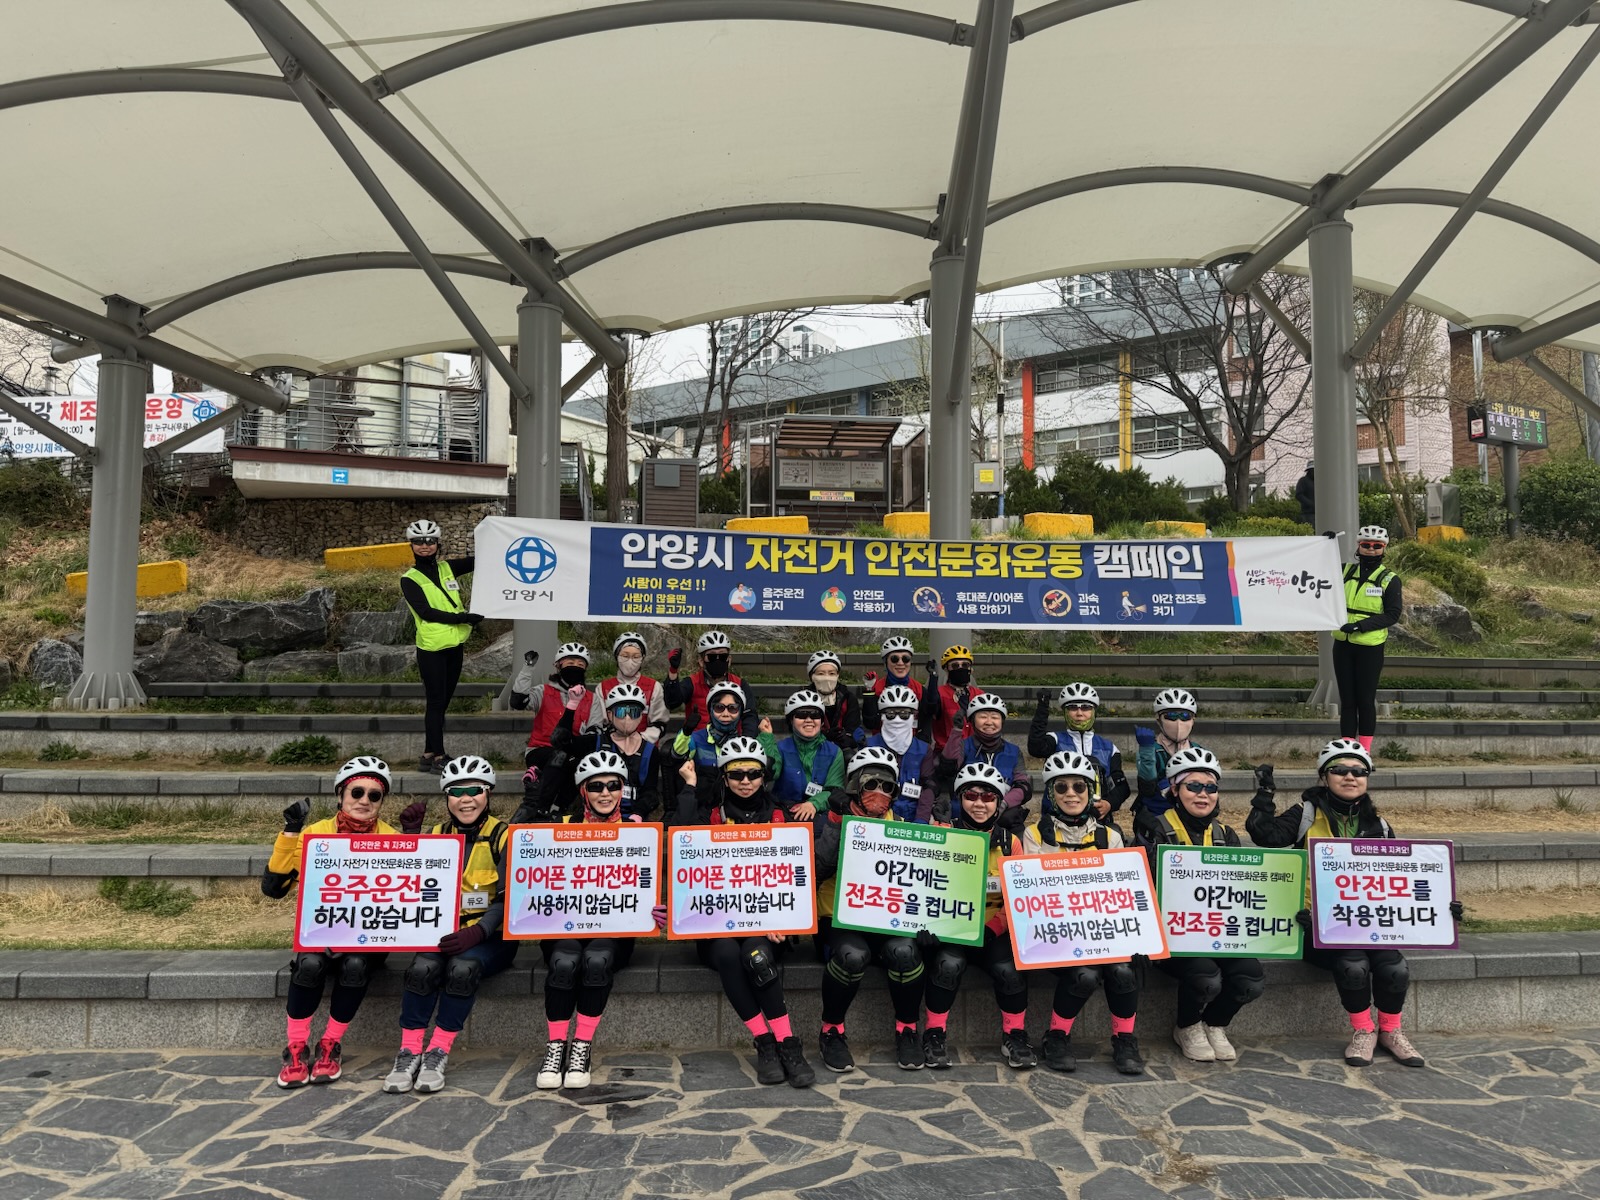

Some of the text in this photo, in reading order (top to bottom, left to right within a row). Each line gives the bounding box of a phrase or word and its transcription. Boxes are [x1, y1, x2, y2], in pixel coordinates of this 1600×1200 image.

[146, 398, 183, 420] 운영
[620, 532, 1204, 580] 안양시 자전거 안전문화운동 캠페인
[623, 577, 662, 590] 사람이
[666, 578, 692, 591] 우선
[1291, 570, 1332, 599] 안양
[502, 589, 553, 602] 안양시
[622, 593, 686, 604] 사람이 많을땐
[762, 588, 804, 599] 음주운전
[853, 590, 884, 600] 안전모
[956, 592, 1024, 603] 휴대폰/이어폰
[1078, 593, 1099, 603] 과속
[1151, 593, 1206, 605] 야간 전조등
[622, 604, 653, 614] 내려서
[762, 600, 784, 611] 금지
[853, 602, 895, 614] 착용하기
[957, 604, 1011, 615] 사용 안하기
[1078, 605, 1100, 616] 금지
[1152, 606, 1175, 617] 켜기
[557, 830, 616, 839] 이것만은 꼭 지켜요!
[713, 830, 770, 840] 이것만은 꼭 지켜요!
[887, 827, 945, 842] 이것만은 꼭 지켜요!
[353, 841, 416, 850] 이것만은 꼭 지켜요!
[852, 839, 977, 865] 안양시 자전거 안전문화운동 캠페인
[1354, 845, 1410, 854] 이것만은 꼭 지켜요!
[520, 847, 650, 859] 안양시 자전거 안전문화운동 캠페인
[680, 846, 803, 860] 안양시 자전거 안전문화운동 캠페인
[1204, 853, 1261, 863] 이것만은 꼭 지켜요!
[314, 858, 451, 869] 안양시 자전거 안전문화운동 캠페인
[1044, 857, 1102, 868] 이것만은 꼭 지켜요!
[1322, 861, 1444, 873] 안양시 자전거 안전문화운동 캠페인
[515, 864, 653, 891] 이어폰 휴대전화를
[677, 862, 807, 890] 이어폰 휴대전화를
[875, 859, 950, 891] 야간에는
[1013, 870, 1140, 889] 안양시 자전거 안전문화운동 캠페인
[1170, 869, 1294, 883] 안양시 자전거 안전문화운동 캠페인
[319, 873, 442, 903] 음주운전을
[1334, 874, 1432, 901] 안전모를
[467, 897, 484, 906] 듀오
[528, 893, 639, 916] 사용하지 않습니다
[690, 892, 795, 916] 사용하지 않습니다
[845, 882, 975, 922] 전조등을 켭니다
[1013, 888, 1149, 919] 이어폰 휴대전화를
[1194, 885, 1268, 911] 야간에는
[314, 905, 442, 930] 하지 않습니다
[1332, 904, 1438, 928] 착용합니다
[1167, 911, 1294, 937] 전조등을 켭니다
[1033, 917, 1141, 945] 사용하지 않습니다
